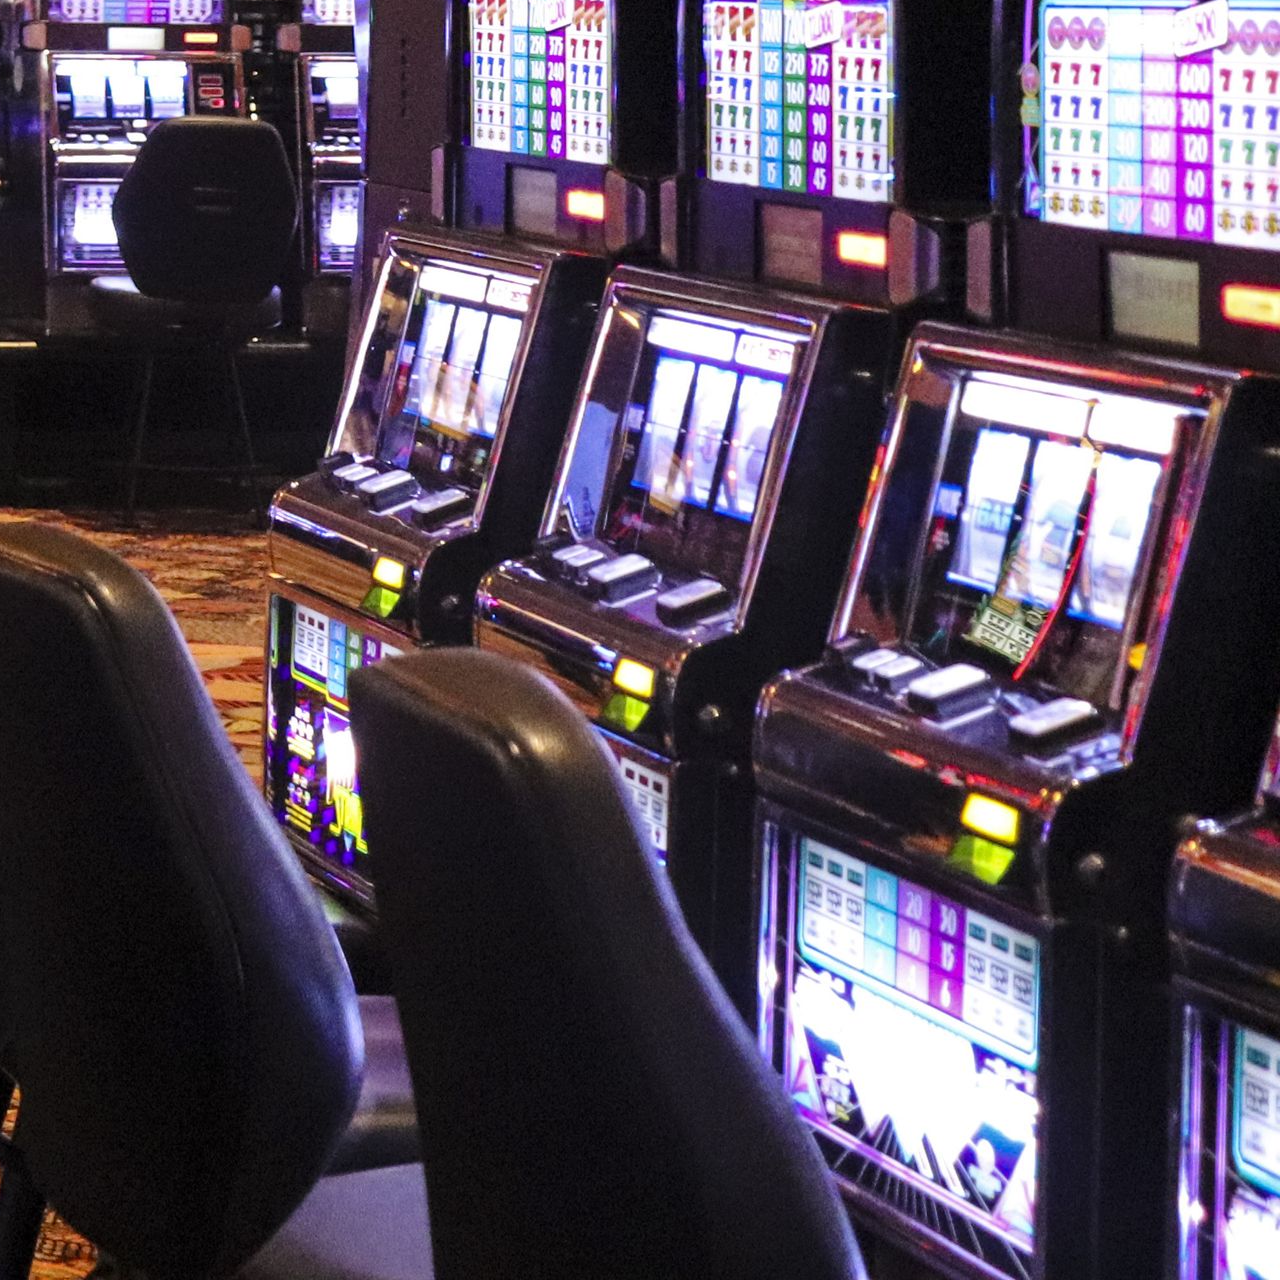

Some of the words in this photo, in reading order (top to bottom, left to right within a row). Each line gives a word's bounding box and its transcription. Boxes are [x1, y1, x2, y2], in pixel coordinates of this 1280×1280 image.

[764, 52, 779, 73] 125
[785, 53, 804, 75] 250
[810, 54, 829, 77] 375
[1179, 64, 1210, 93] 600
[550, 87, 562, 107] 90
[786, 81, 805, 104] 160
[809, 83, 830, 107] 240
[765, 108, 778, 130] 30
[788, 110, 802, 133] 60
[812, 113, 827, 136] 90
[1180, 98, 1209, 128] 300
[551, 134, 562, 154] 45
[765, 135, 778, 158] 20
[788, 138, 802, 160] 40
[812, 141, 827, 164] 60
[1183, 135, 1208, 162] 120
[767, 163, 776, 183] 15
[789, 165, 802, 187] 30
[813, 168, 826, 190] 45
[1151, 167, 1170, 194] 40
[1185, 169, 1205, 197] 60
[1151, 201, 1170, 228] 40
[1185, 204, 1205, 232] 60
[906, 891, 923, 920] 20
[940, 904, 957, 936] 30
[908, 927, 921, 954] 10
[941, 941, 955, 971] 15
[942, 979, 951, 1009] 6
